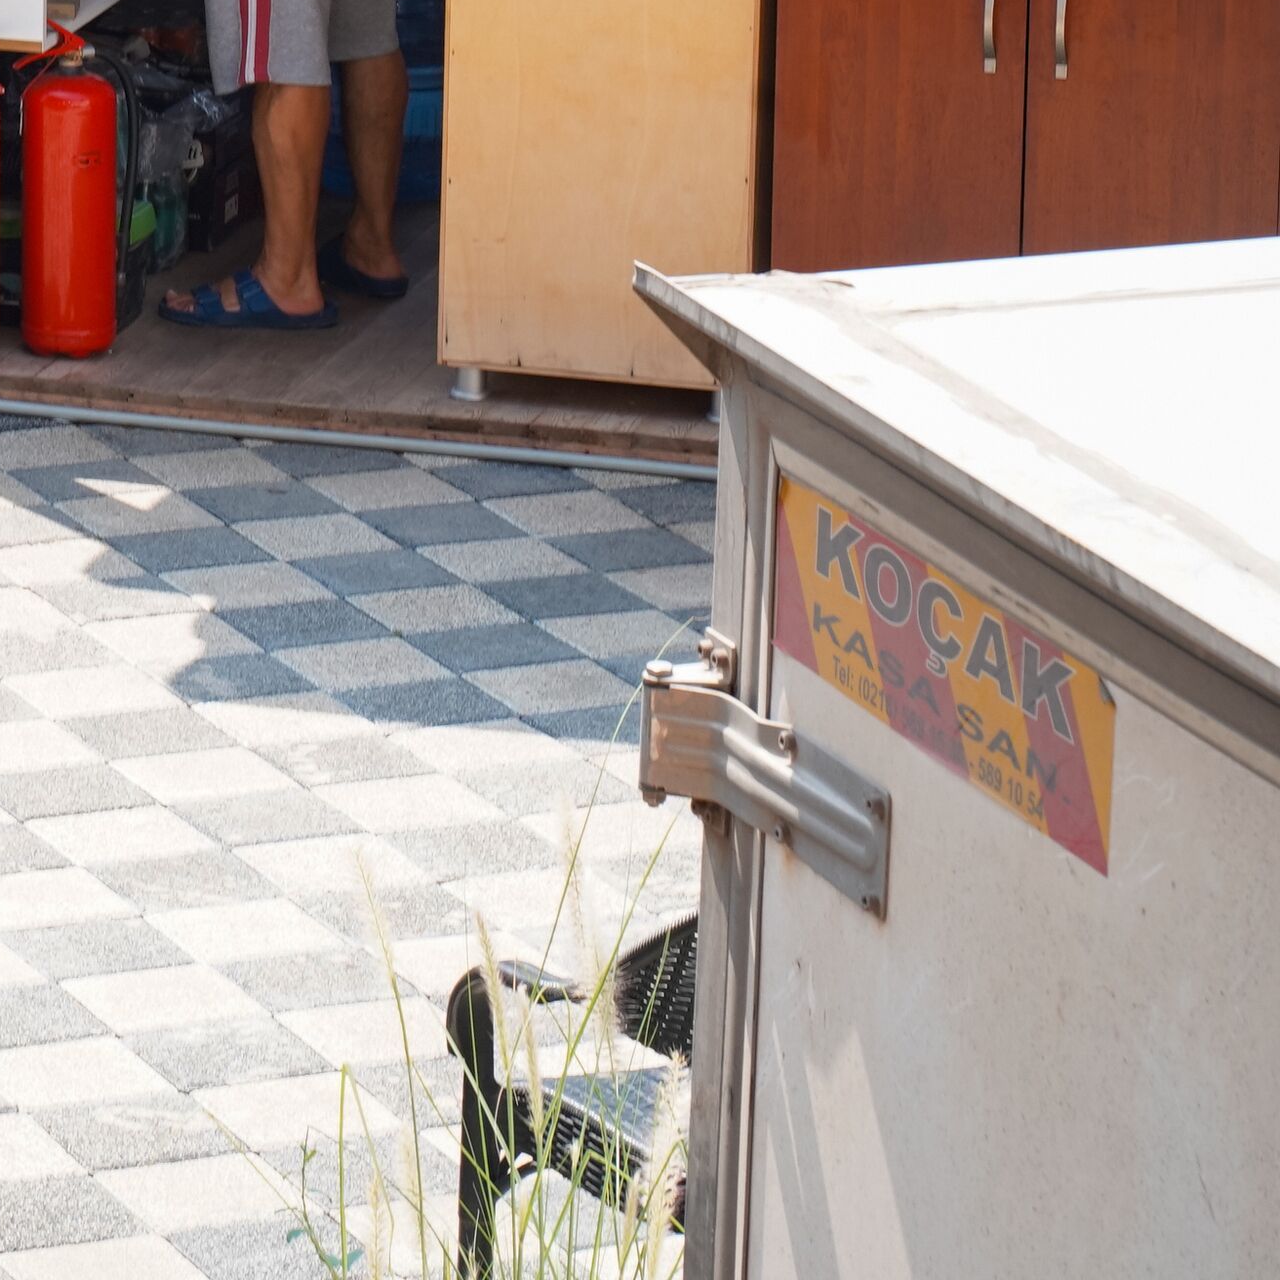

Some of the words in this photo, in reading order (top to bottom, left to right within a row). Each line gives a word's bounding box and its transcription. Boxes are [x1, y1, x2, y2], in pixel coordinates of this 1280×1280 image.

[812, 601, 942, 716] KASA
[815, 503, 1077, 746] KOÇAK
[832, 654, 854, 692] Tel:
[978, 756, 1003, 793] 589
[1007, 777, 1024, 806] 10
[1028, 791, 1045, 818] 54
